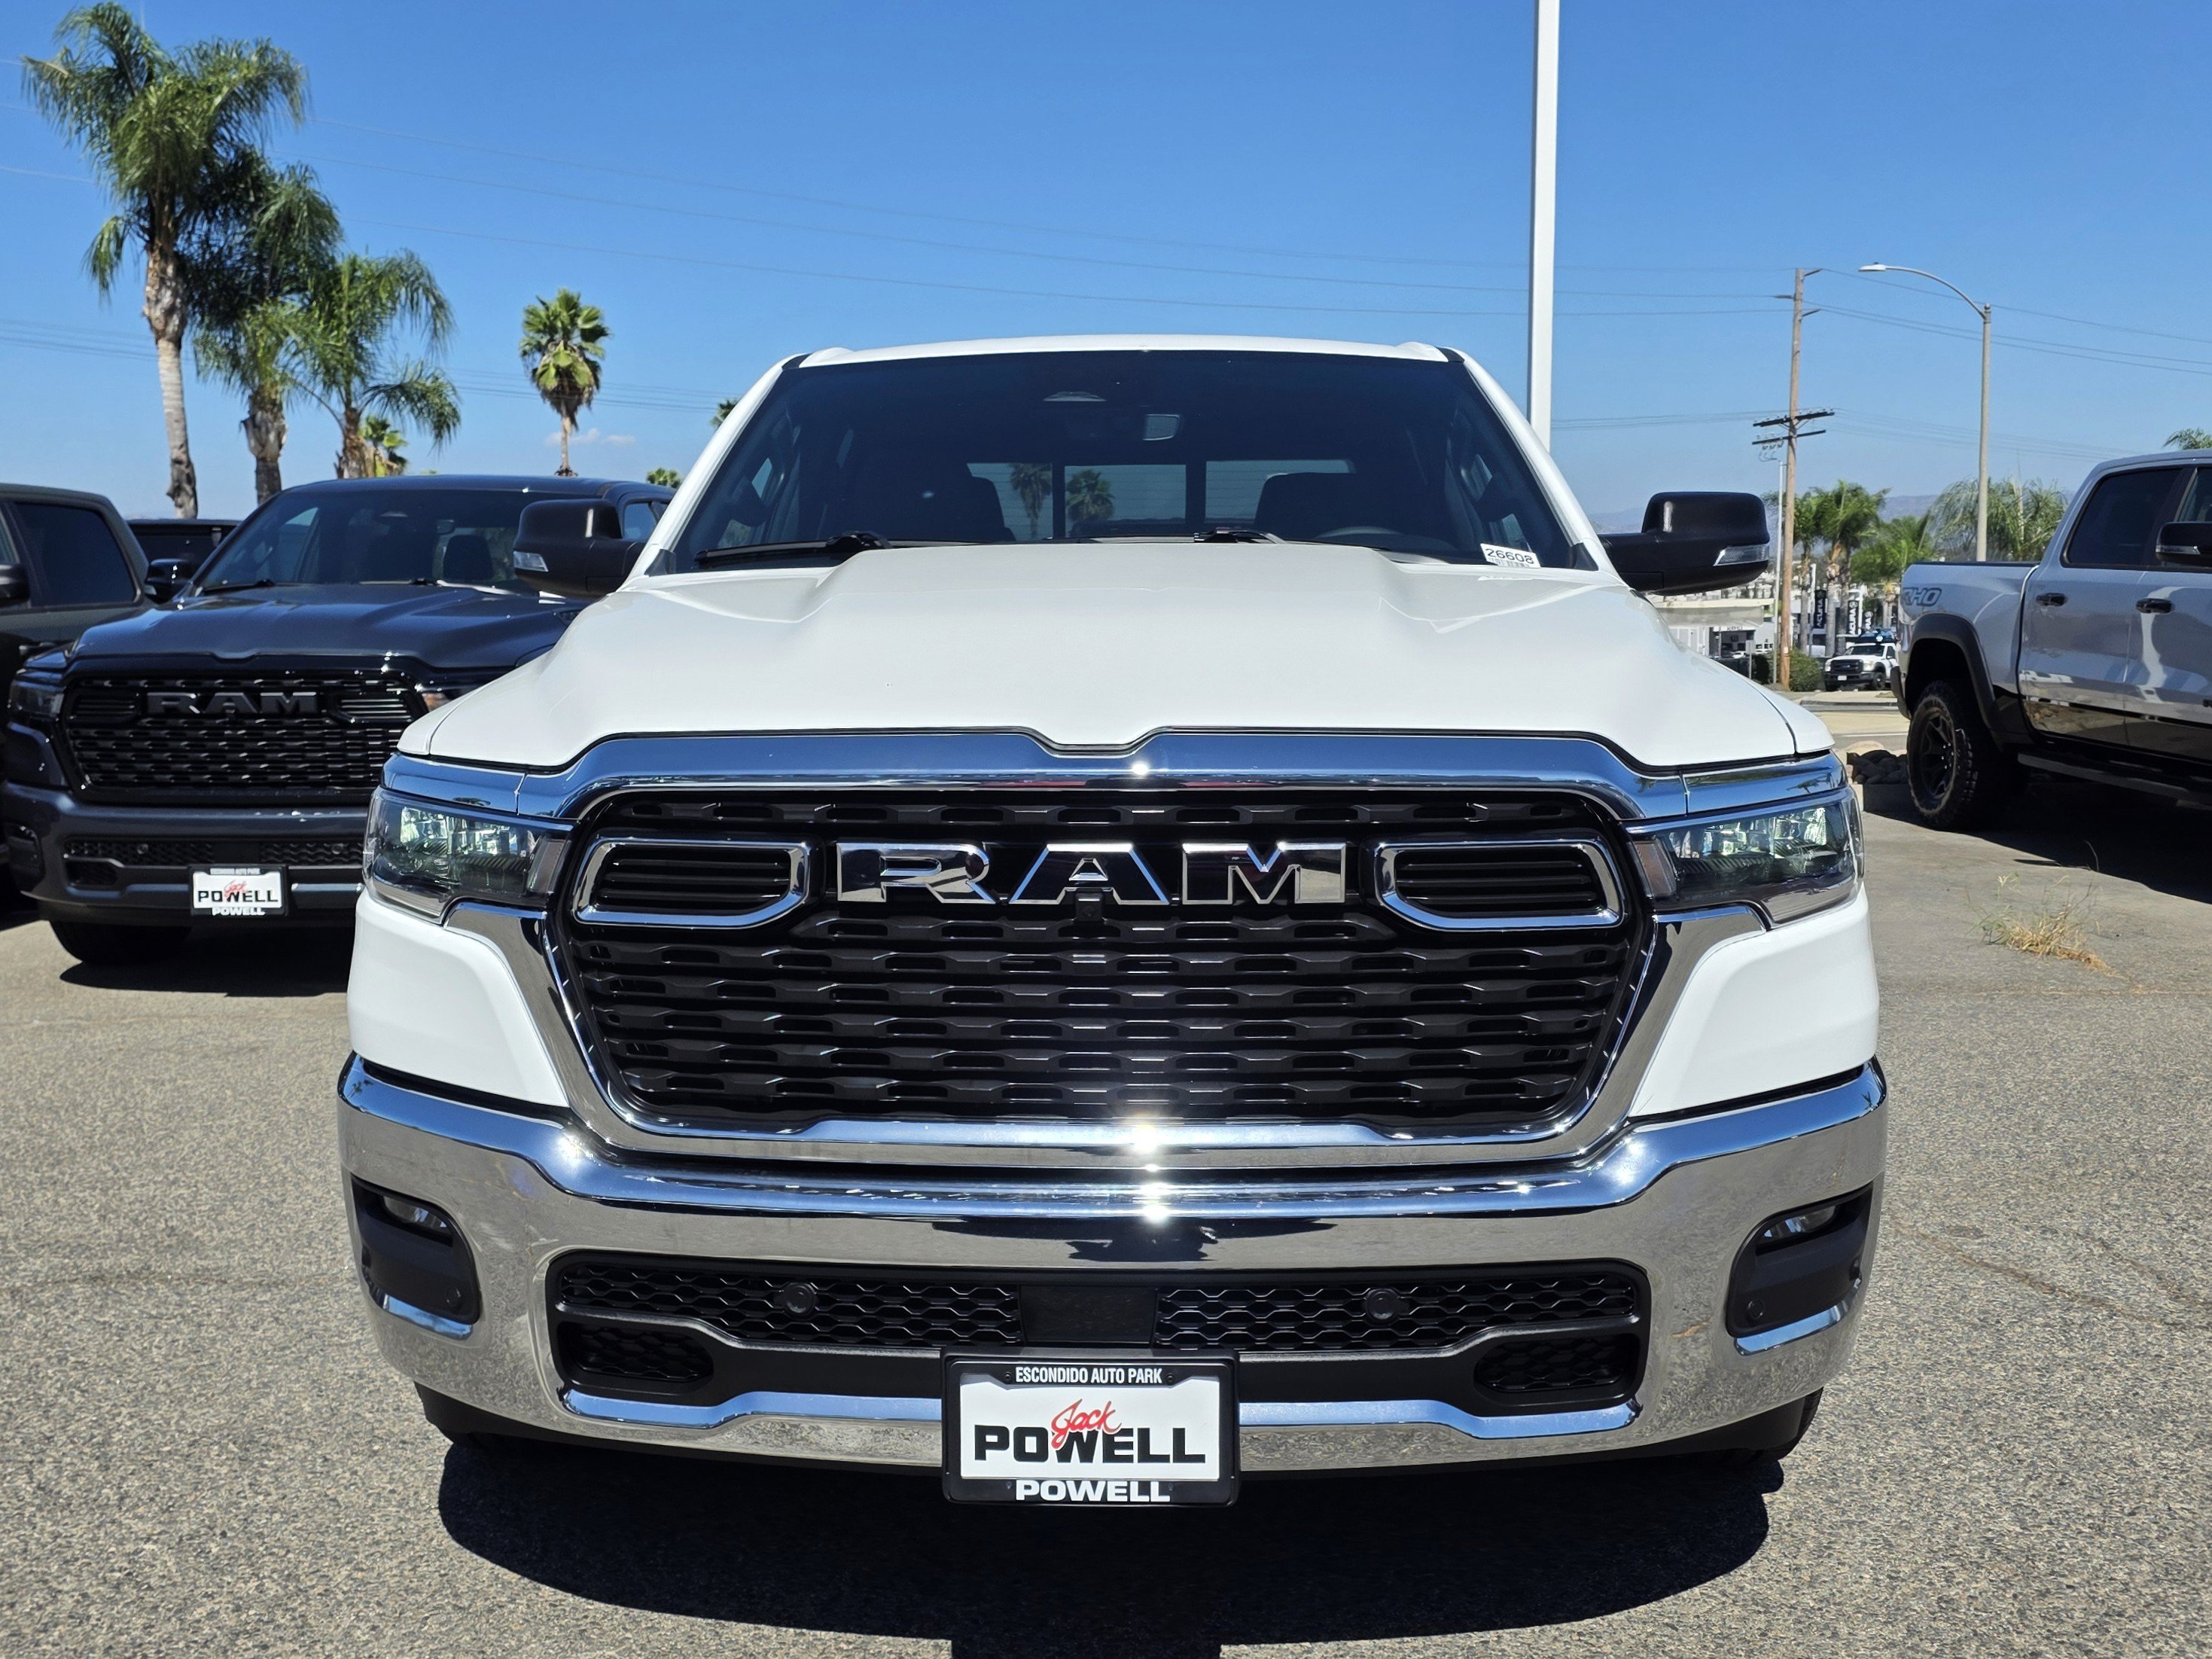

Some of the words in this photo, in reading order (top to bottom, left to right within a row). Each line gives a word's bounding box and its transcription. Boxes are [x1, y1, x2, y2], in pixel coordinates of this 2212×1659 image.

[1485, 548, 1534, 564] 26608
[148, 692, 317, 714] RAM
[836, 843, 1346, 904] RAM
[198, 890, 278, 902] POWELL
[212, 907, 266, 916] POWELL
[1016, 1367, 1089, 1383] ESCONDIDO
[1091, 1368, 1125, 1383] AUTO
[1128, 1368, 1162, 1383] PARK
[1051, 1398, 1122, 1450] Jack
[974, 1425, 1206, 1463] POWELL
[1016, 1481, 1171, 1502] POWELL
